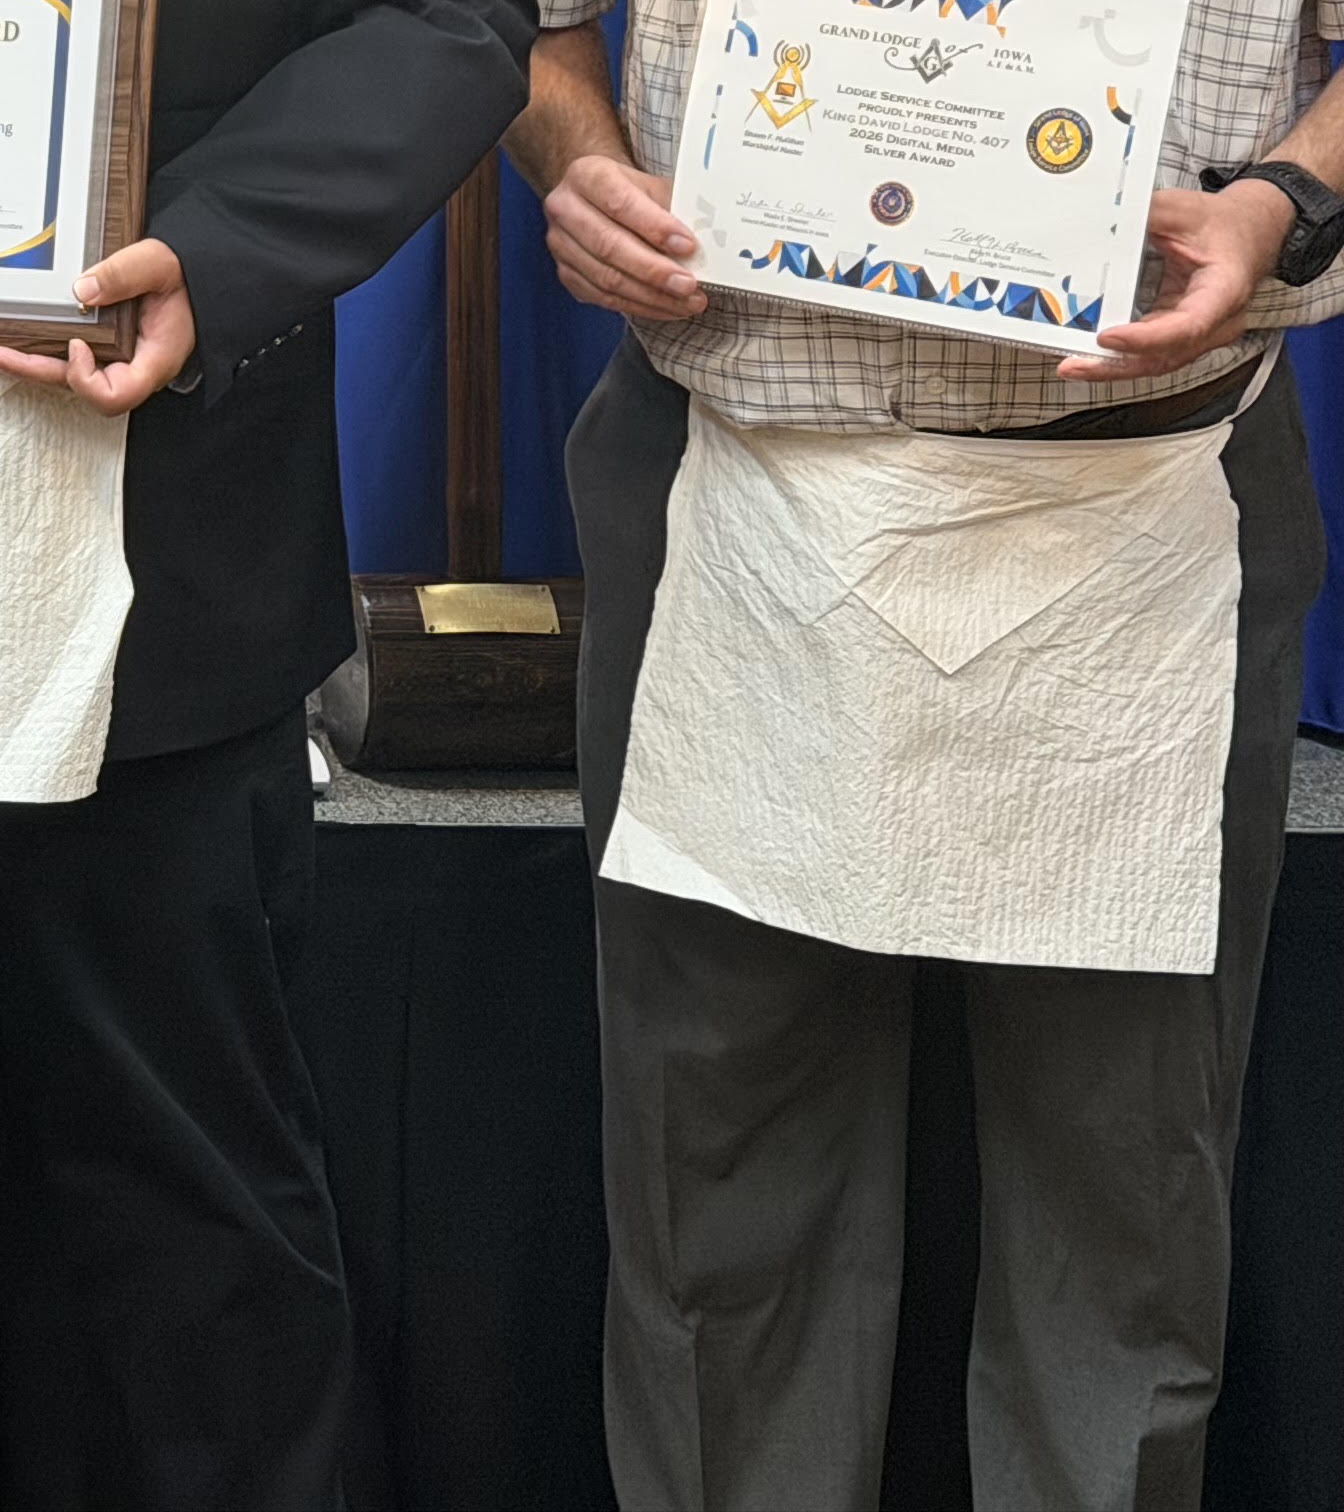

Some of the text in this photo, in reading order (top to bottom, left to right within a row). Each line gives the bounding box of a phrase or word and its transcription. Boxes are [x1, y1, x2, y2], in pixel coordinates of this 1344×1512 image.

[819, 23, 870, 41] GRAND
[872, 31, 922, 49] LODGE
[993, 48, 1032, 64] IOWA
[837, 84, 1005, 121] LODGE SERVICE COMMITTEE
[858, 102, 978, 129] PROUDLY PRESENTS
[849, 128, 975, 158] 2026 DIGITAL MEDIA
[980, 135, 1010, 150] 407
[864, 144, 956, 168] SILVER AWARD
